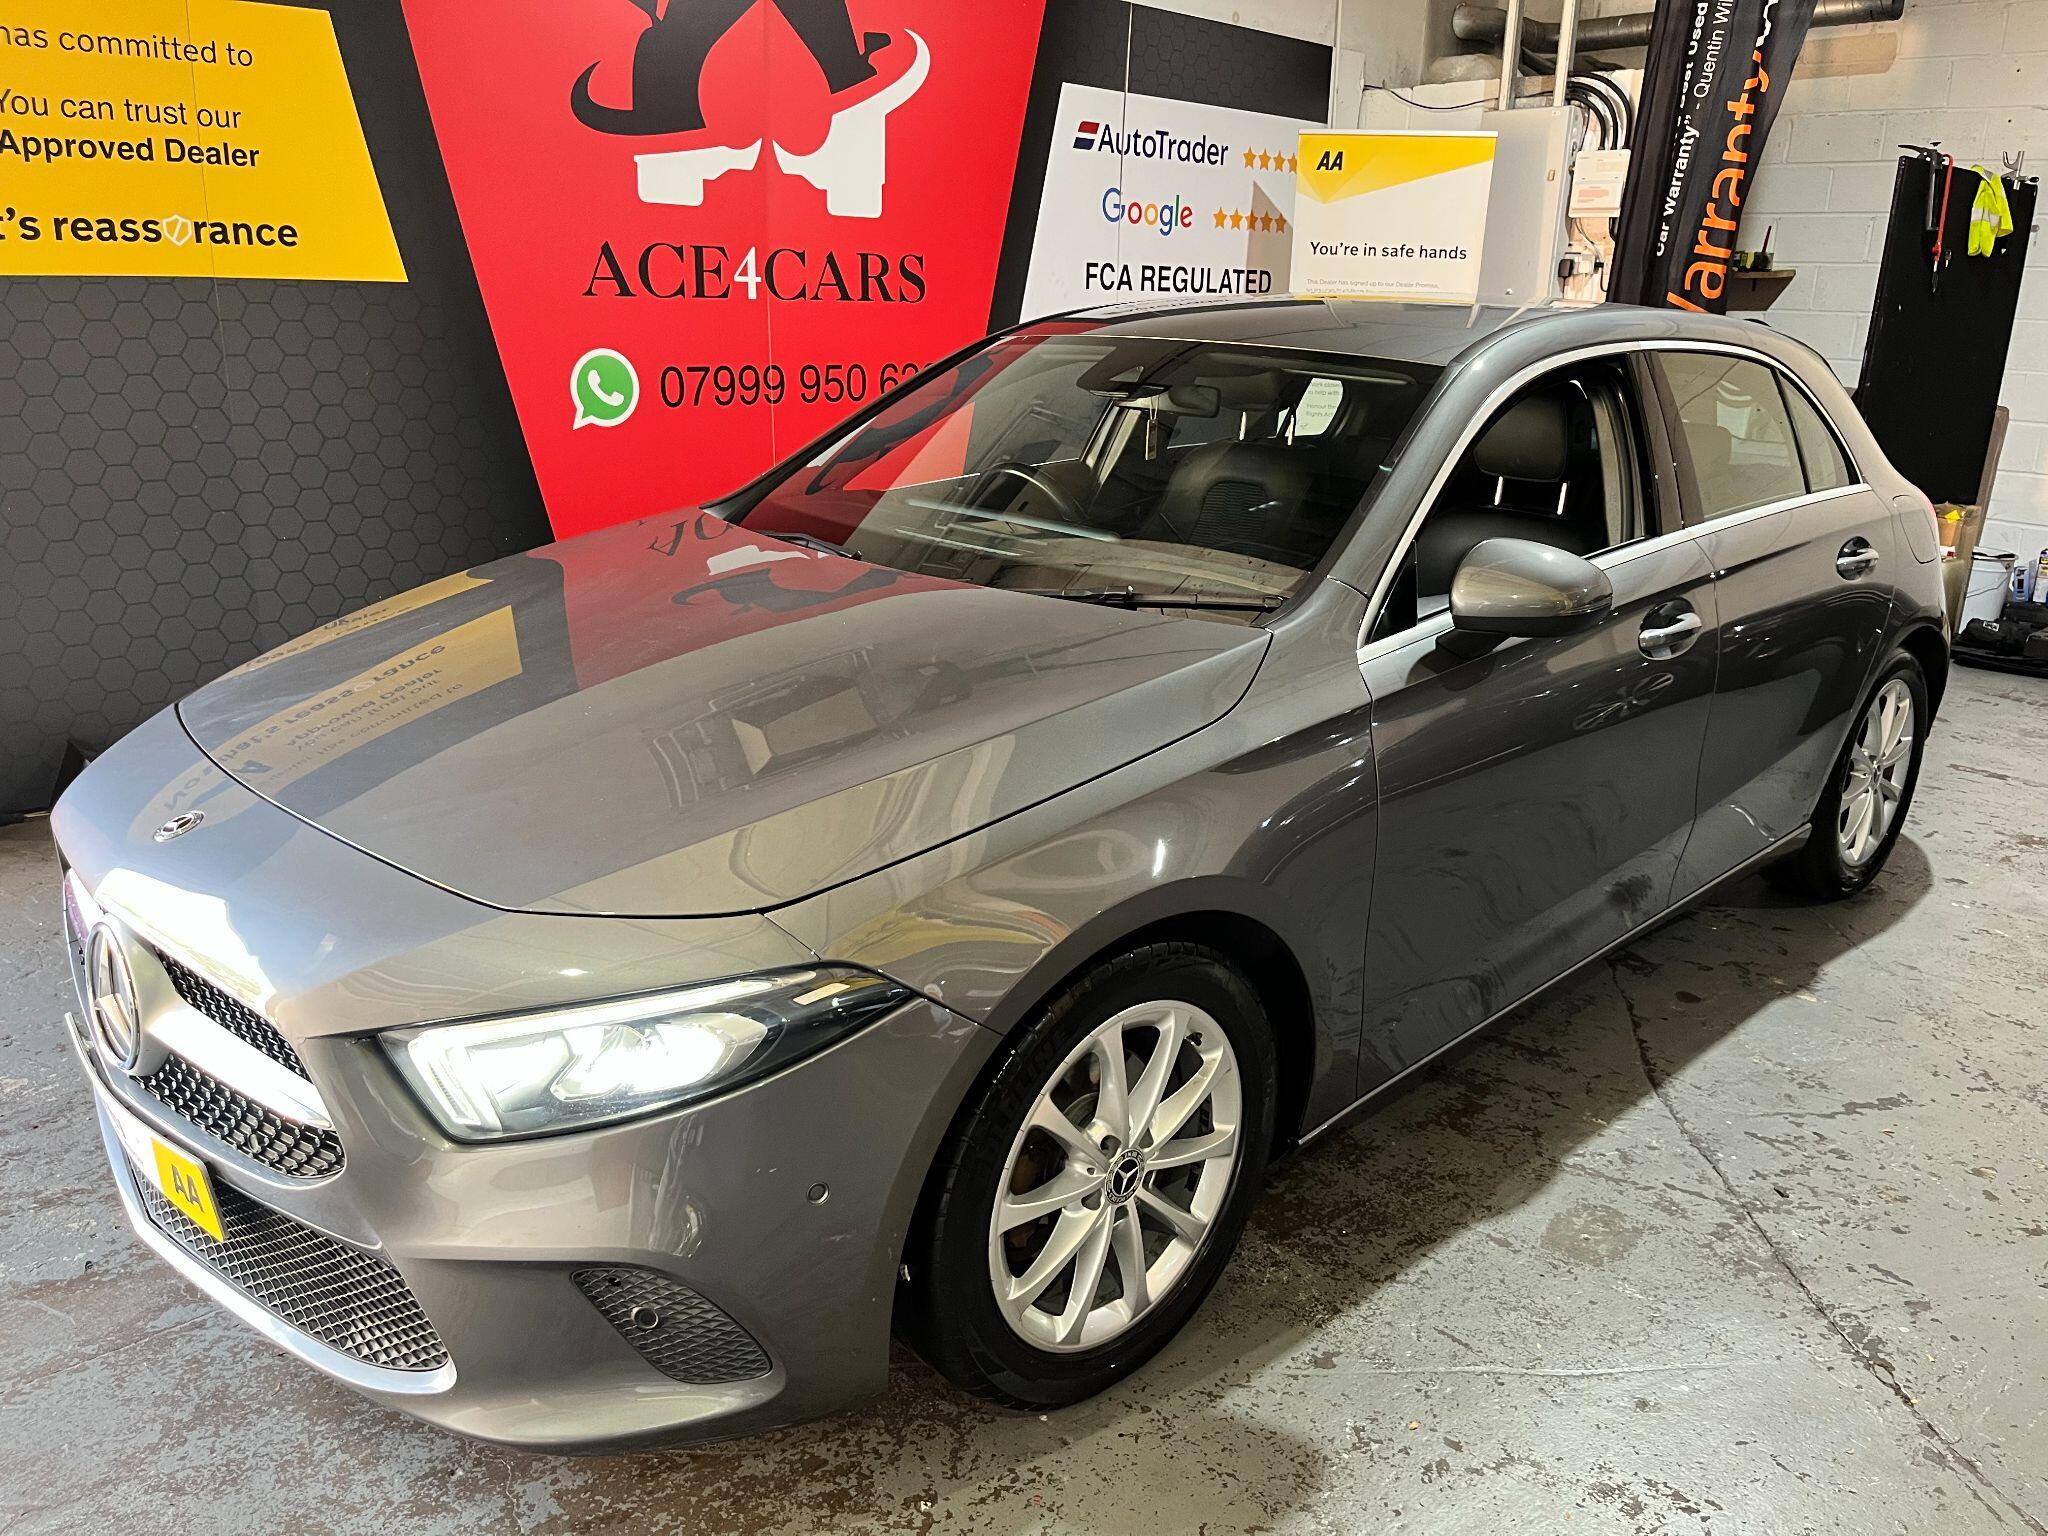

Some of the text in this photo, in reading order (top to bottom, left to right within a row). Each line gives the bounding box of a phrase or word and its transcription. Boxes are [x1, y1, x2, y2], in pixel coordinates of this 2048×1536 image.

[58, 31, 218, 65] committed
[227, 43, 254, 67] to
[1693, 29, 1725, 98] Quentin
[60, 98, 115, 121] can
[123, 98, 188, 126] trust
[196, 108, 242, 129] our
[0, 129, 261, 167] Approved Dealer
[1097, 123, 1229, 166] AutoTrader
[1316, 150, 1344, 171] AA
[1102, 187, 1193, 236] Google
[1363, 242, 1377, 258] in
[1381, 243, 1414, 260] safe
[1419, 245, 1468, 260] hands
[582, 240, 927, 304] ACE4CARS
[1085, 262, 1272, 294] FCA REGULATED
[659, 363, 786, 409] 07999
[799, 363, 868, 404] 950
[171, 1163, 205, 1214] AA
